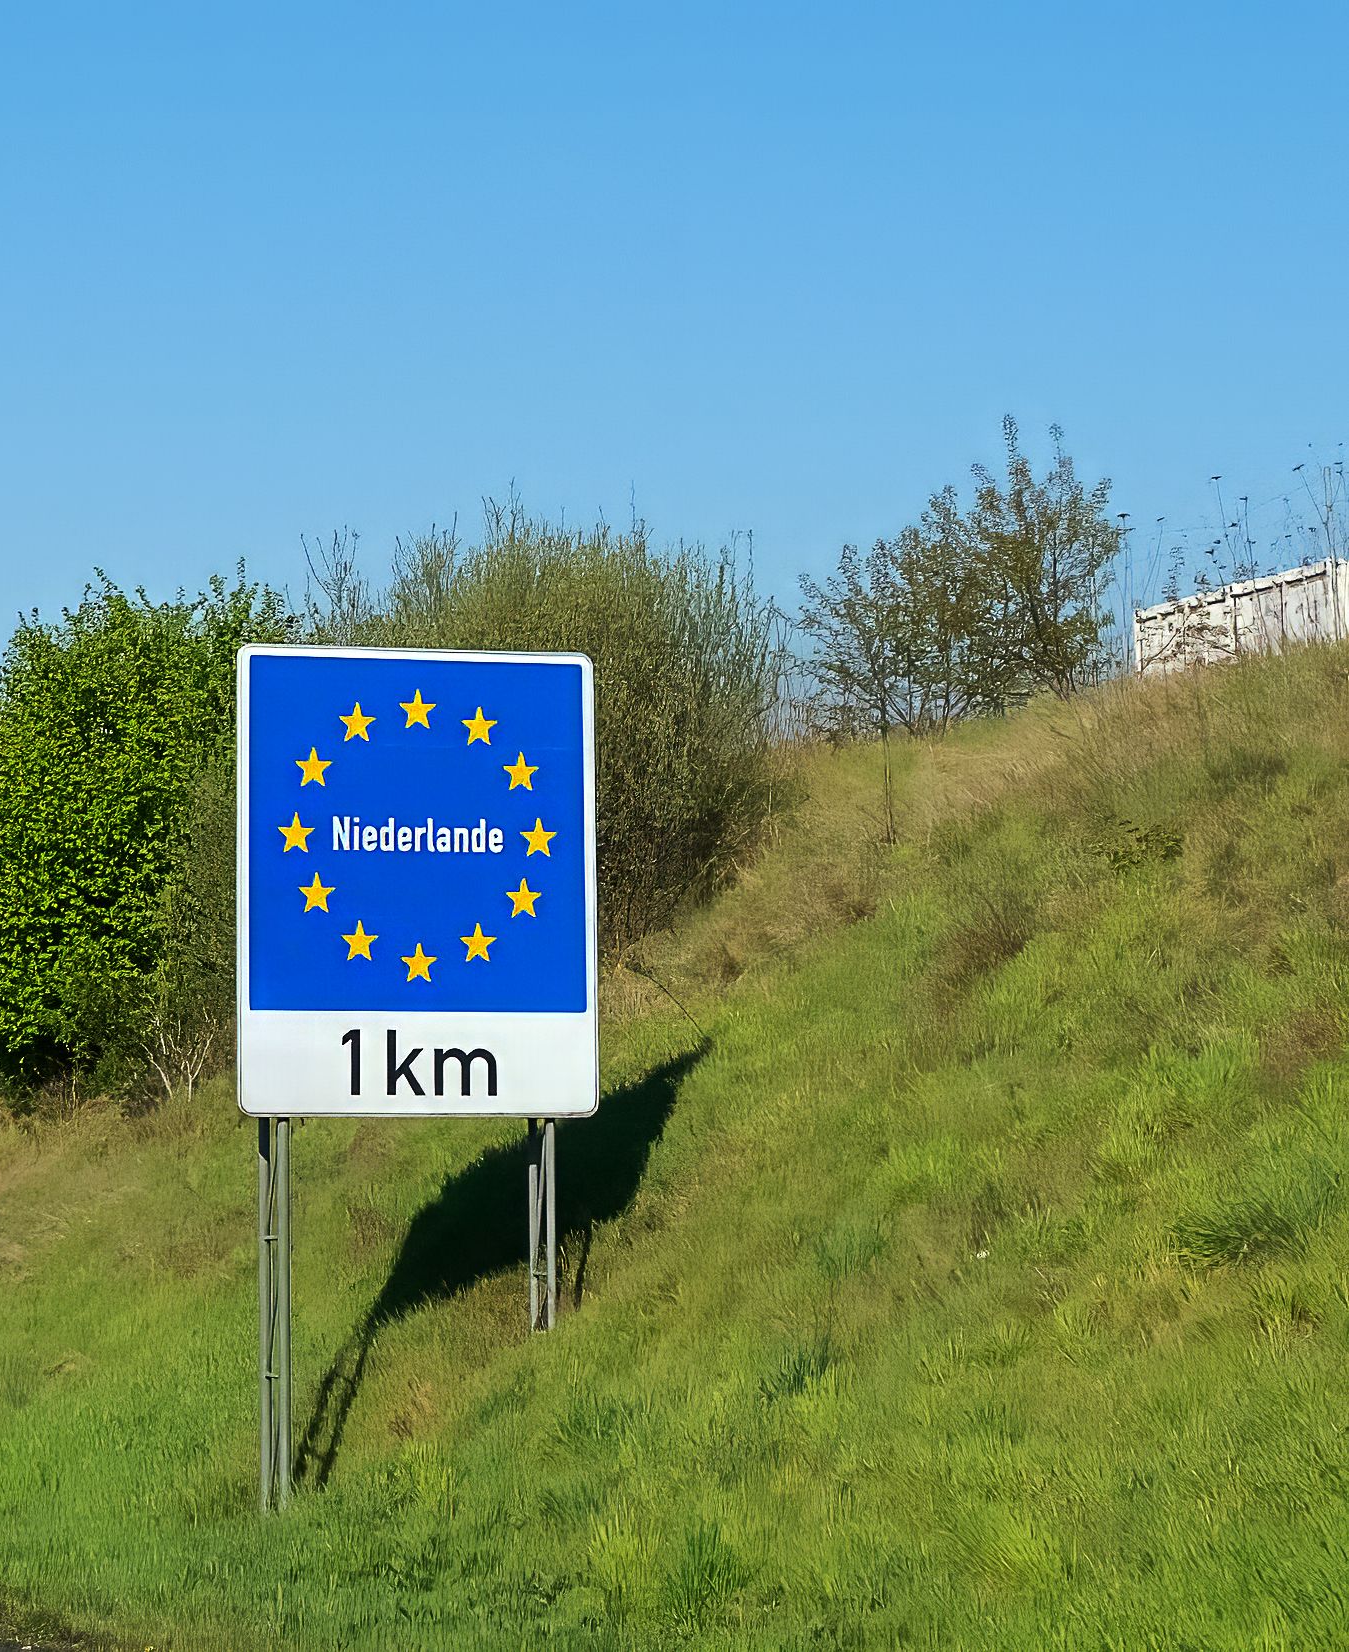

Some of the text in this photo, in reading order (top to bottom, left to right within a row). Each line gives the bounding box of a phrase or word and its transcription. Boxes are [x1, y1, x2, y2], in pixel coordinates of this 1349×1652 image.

[332, 816, 504, 853] Niederlande
[341, 1029, 498, 1096] 1 km
